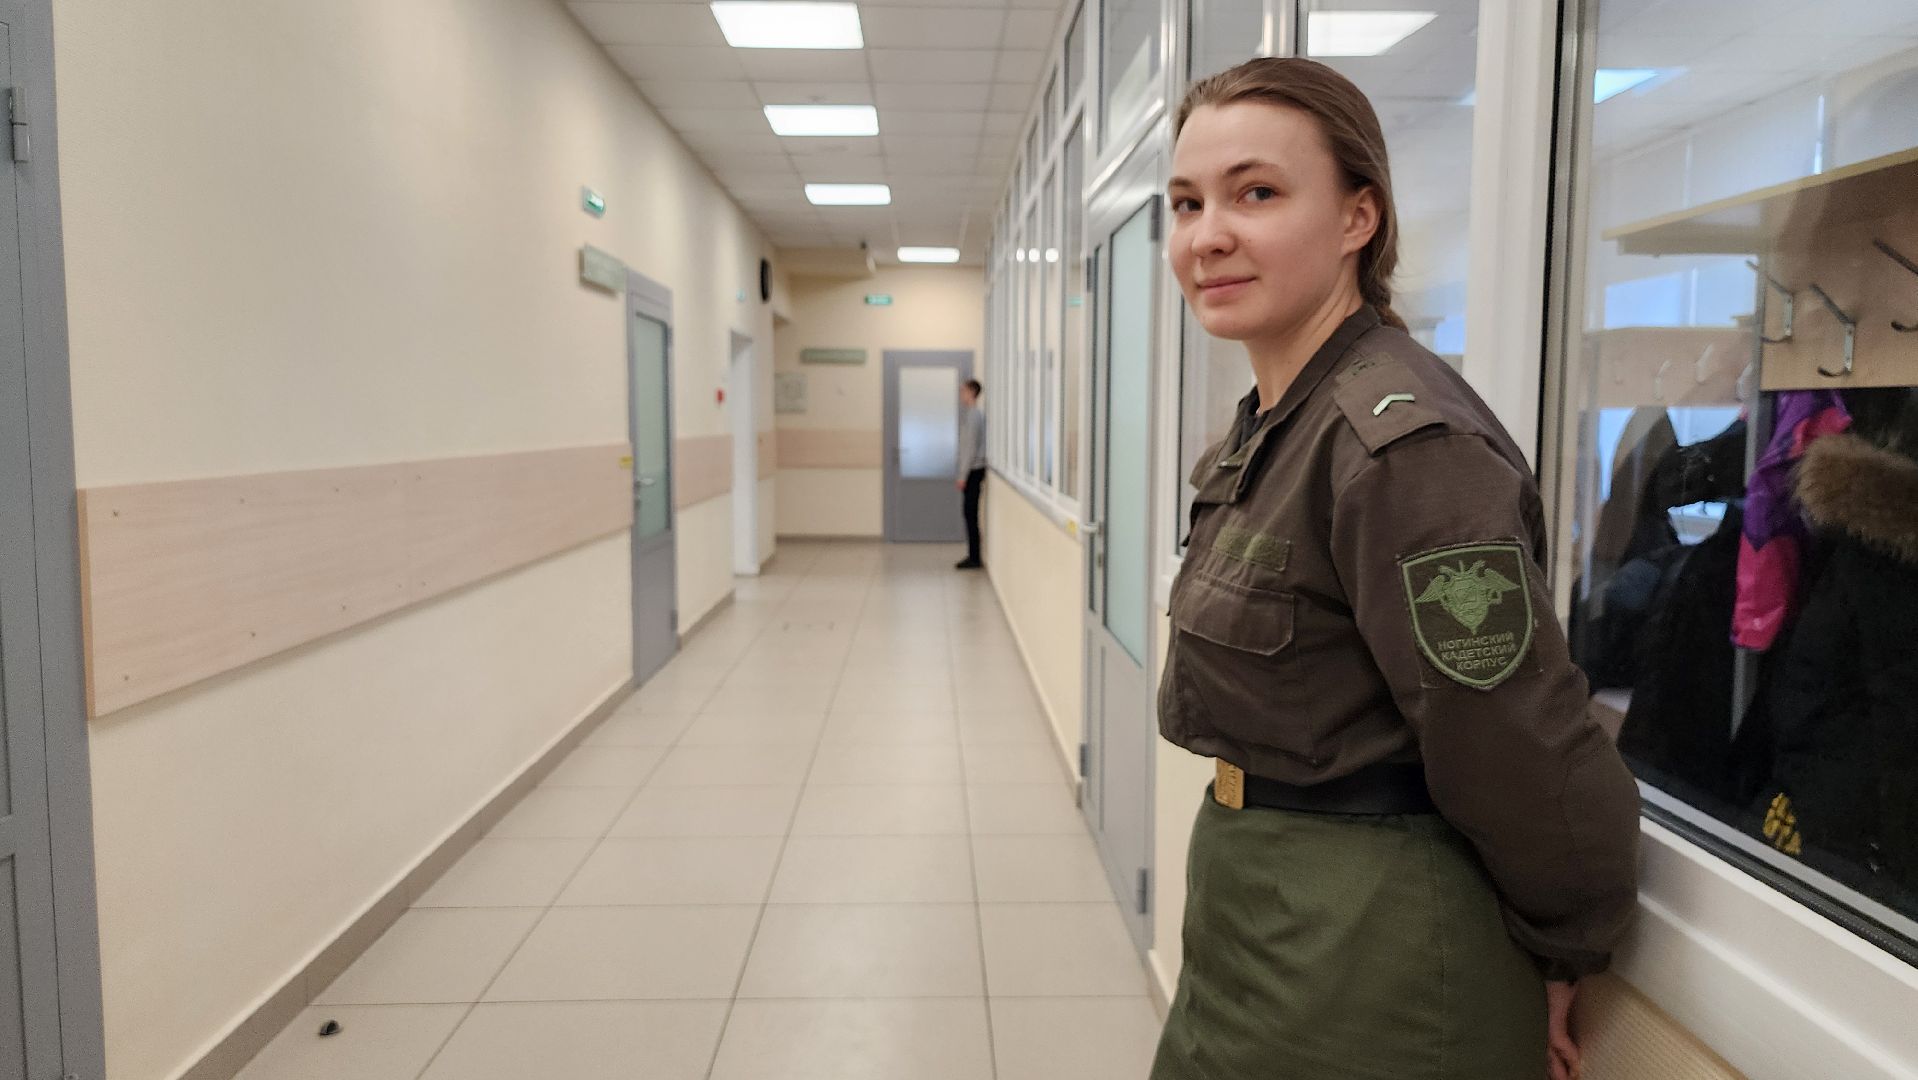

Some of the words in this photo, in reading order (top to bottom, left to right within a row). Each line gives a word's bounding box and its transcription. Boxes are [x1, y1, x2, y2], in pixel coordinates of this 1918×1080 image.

[1437, 631, 1515, 649] НОГИНСКИЙ
[1441, 643, 1516, 661] КАДЕТСКИЙ
[1456, 656, 1507, 671] КОРПУС
